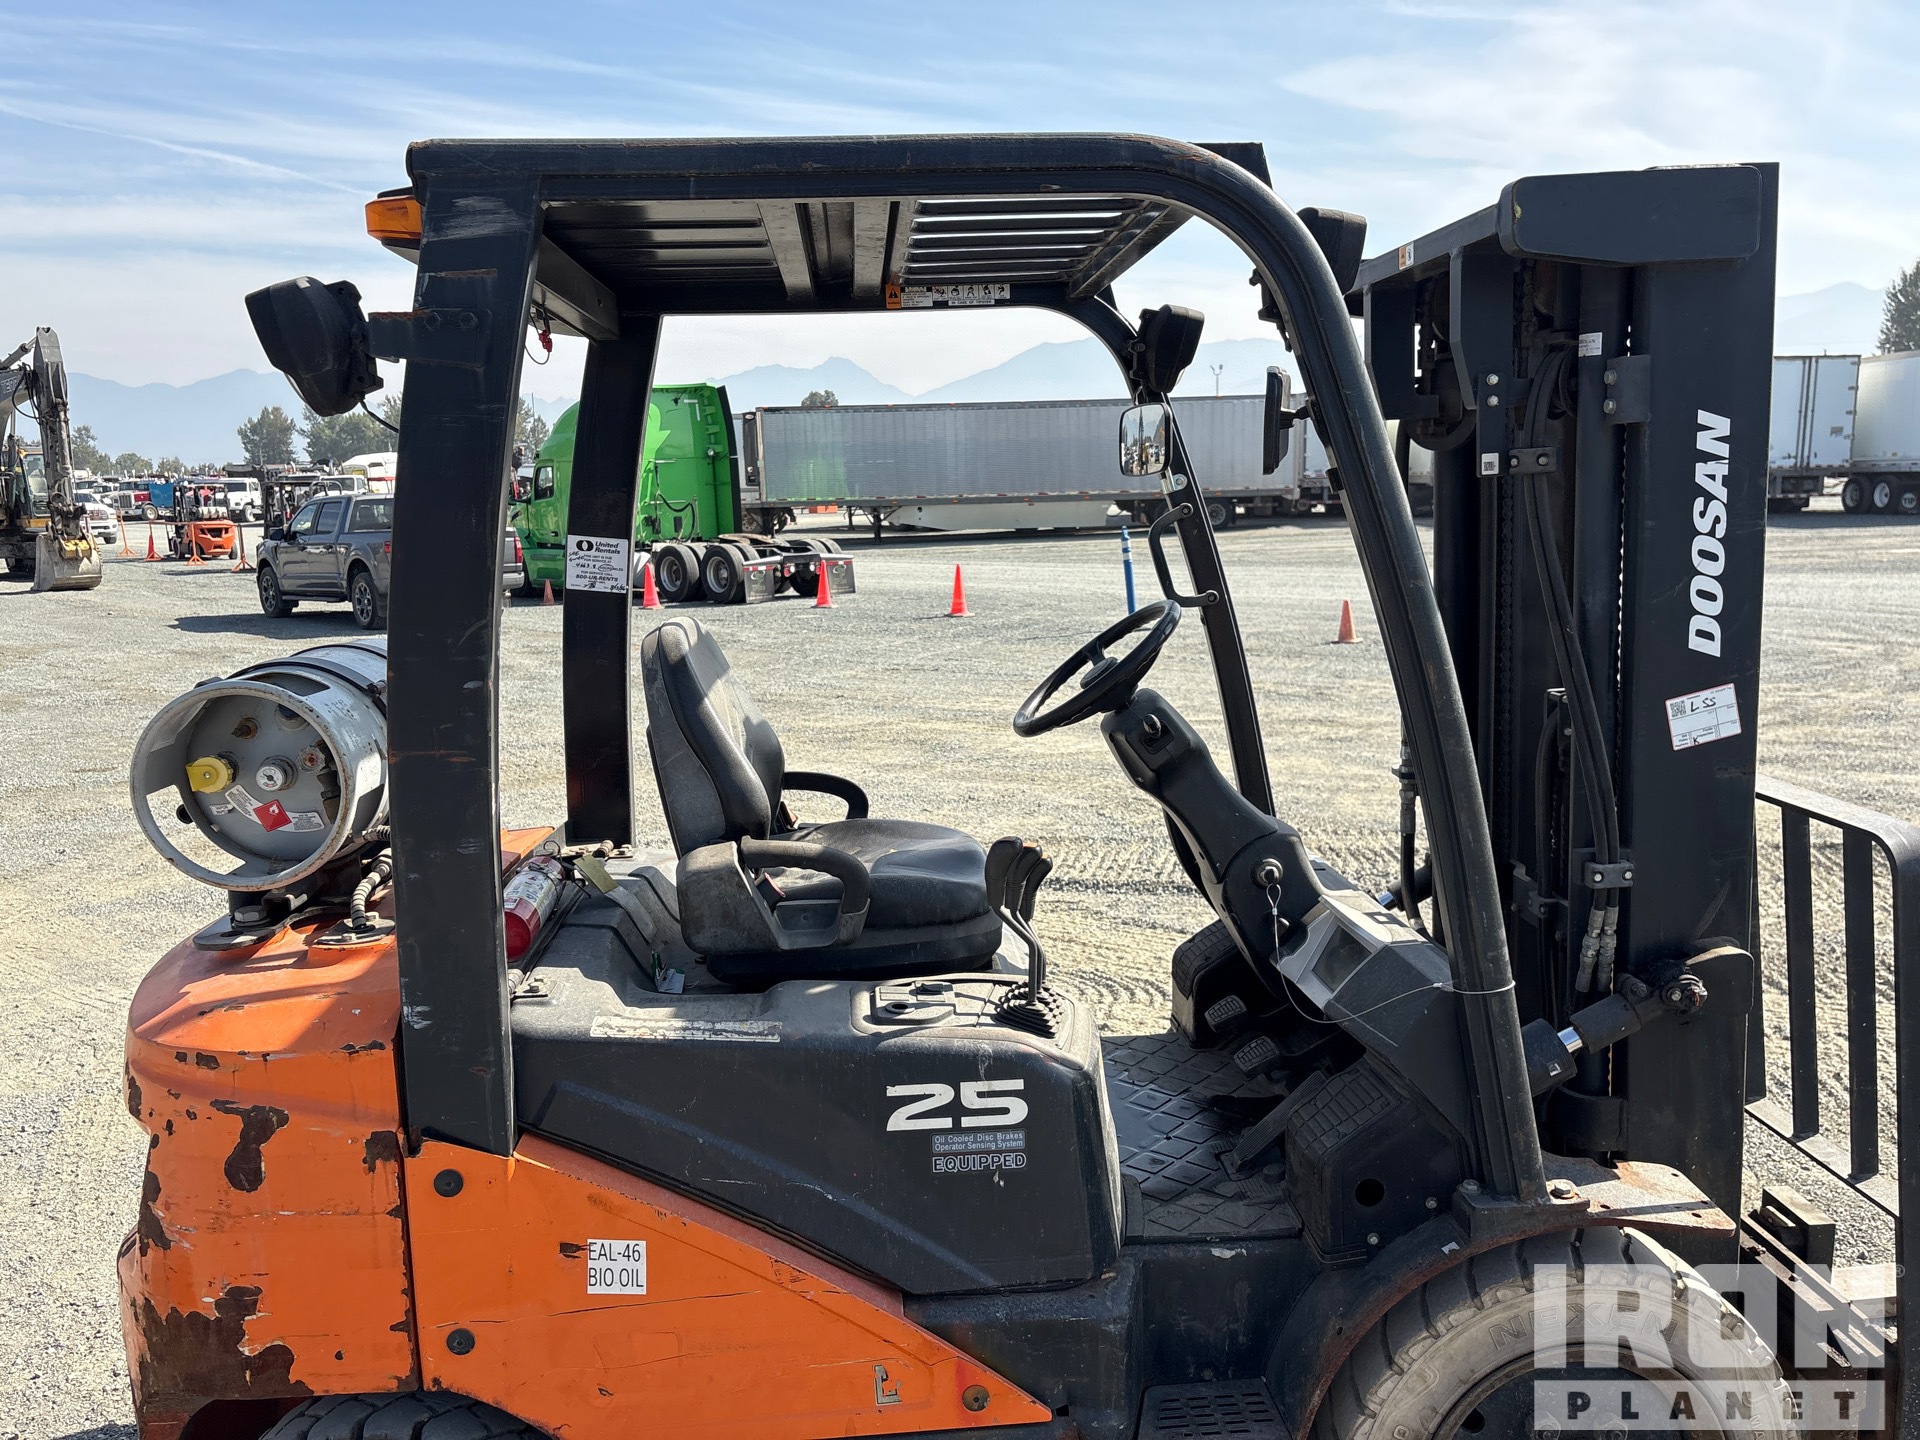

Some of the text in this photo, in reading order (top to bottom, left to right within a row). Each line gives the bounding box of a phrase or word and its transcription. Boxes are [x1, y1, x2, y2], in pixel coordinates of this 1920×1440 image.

[1688, 409, 1731, 657] DOOSAN
[594, 547, 621, 555] Rentals
[595, 541, 620, 549] United
[576, 574, 619, 582] 800-UR-RENTS
[886, 1078, 1029, 1132] 25
[934, 1131, 1023, 1143] Oil Cooled Disc Brakes
[934, 1139, 1023, 1152] Operator Sensing System
[932, 1152, 1027, 1173] EQUIPPED
[588, 1242, 641, 1263] EAL-46
[588, 1267, 644, 1288] BIO OIL
